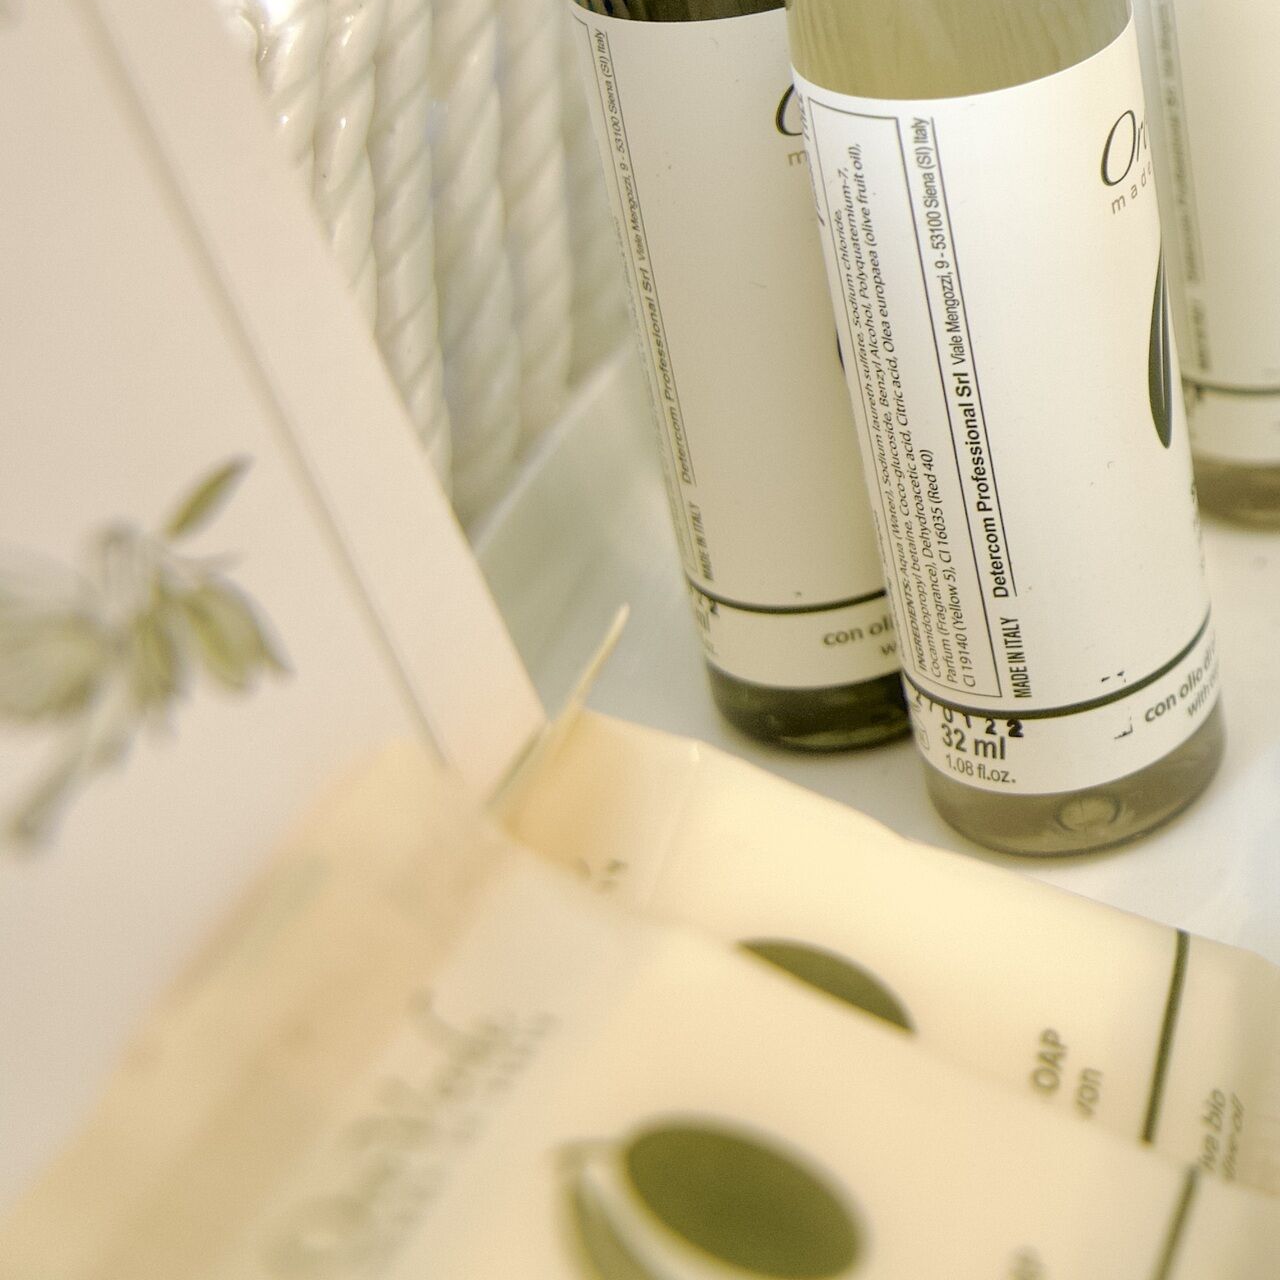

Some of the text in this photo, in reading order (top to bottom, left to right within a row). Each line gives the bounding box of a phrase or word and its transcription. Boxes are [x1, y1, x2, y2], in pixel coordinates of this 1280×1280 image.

[594, 28, 605, 53] Italy
[599, 56, 612, 78] (SI)
[605, 80, 617, 114] Siena
[610, 116, 625, 153] 53100
[910, 117, 930, 144] Italy
[620, 162, 628, 171] 9
[914, 146, 937, 169] (SI)
[922, 172, 940, 208] Siena
[634, 234, 646, 261] Viale
[838, 168, 869, 299] Polyquaternium-7,
[926, 211, 948, 250] 53100
[640, 267, 652, 293] Srl
[934, 260, 950, 269] 9
[846, 273, 861, 328] Sodium
[937, 271, 961, 332] Mengozzi,
[645, 296, 675, 402] Professional
[864, 303, 881, 359] Alcohol,
[948, 335, 966, 365] Viale
[857, 332, 871, 381] sulfate,
[872, 360, 890, 407] Benzyl
[952, 372, 972, 397] Srl
[848, 143, 957, 683] Parfum (Fragrance), Dehydroacetic acid, Citric acid, Olea europaea (olive fruit oil),
[865, 383, 880, 432] laureth
[670, 406, 692, 485] Detercom
[875, 434, 890, 486] Sodium
[884, 411, 910, 517] Coco-glucoside,
[919, 449, 934, 471] 40)
[957, 403, 993, 512] Professional
[923, 473, 943, 504] (Red
[885, 491, 902, 540] (Water),
[931, 507, 948, 545] 16035
[896, 542, 909, 577] Aqua
[904, 520, 920, 572] betaine,
[983, 517, 1009, 598] Detercom
[942, 566, 956, 582] 5),
[903, 578, 927, 671] INGREDIENTS:
[912, 573, 941, 678] Cocamidopropyl
[948, 584, 967, 631] (Yellow
[823, 627, 863, 646] con
[956, 633, 973, 670] 19140
[1000, 616, 1032, 698] MADE IN ITALY
[1144, 693, 1177, 722] con
[1179, 666, 1203, 698] olio
[1187, 682, 1210, 717] with
[941, 721, 1006, 760] 32 ml
[945, 753, 1017, 783] 1.08 fl.oz.
[1029, 1028, 1067, 1097] OAP
